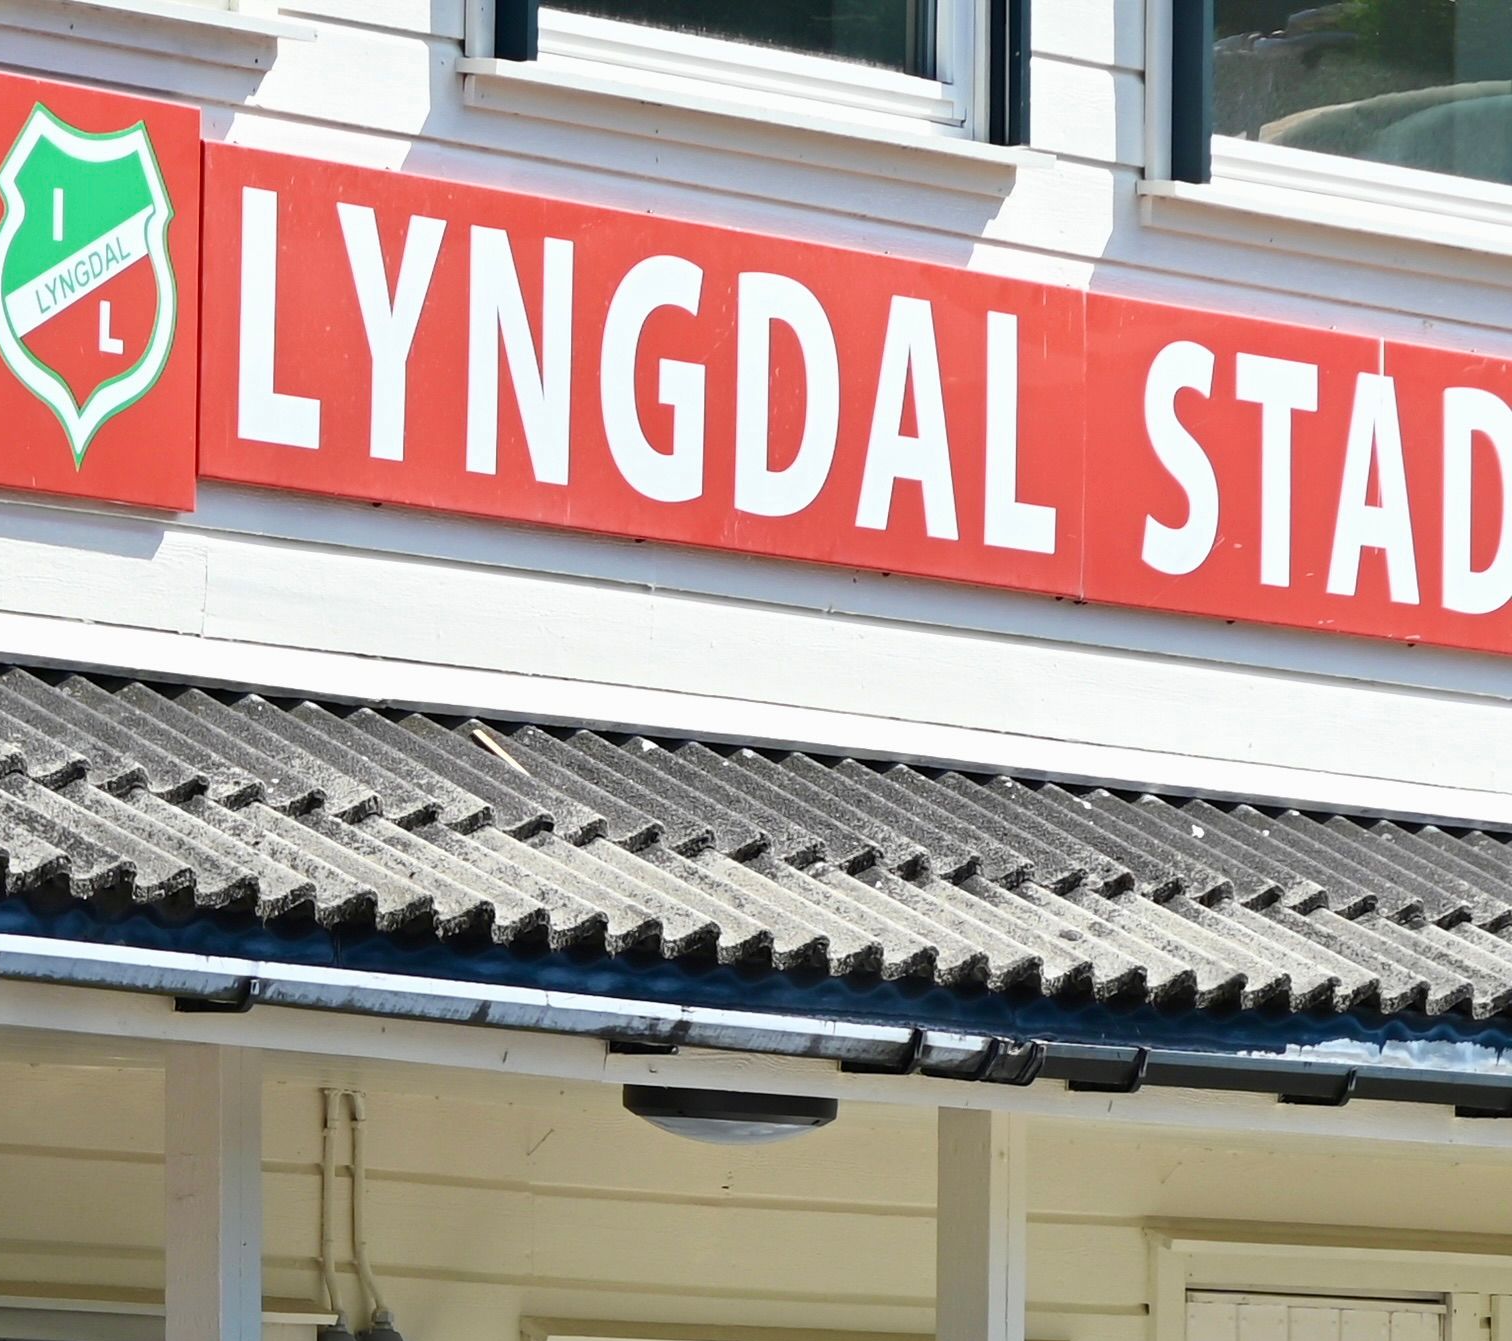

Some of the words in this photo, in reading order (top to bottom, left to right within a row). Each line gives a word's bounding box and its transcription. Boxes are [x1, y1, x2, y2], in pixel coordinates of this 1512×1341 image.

[35, 235, 132, 316] LYNGDAL
[238, 186, 1056, 554] LYNGDAL
[1142, 340, 1512, 614] STAD
